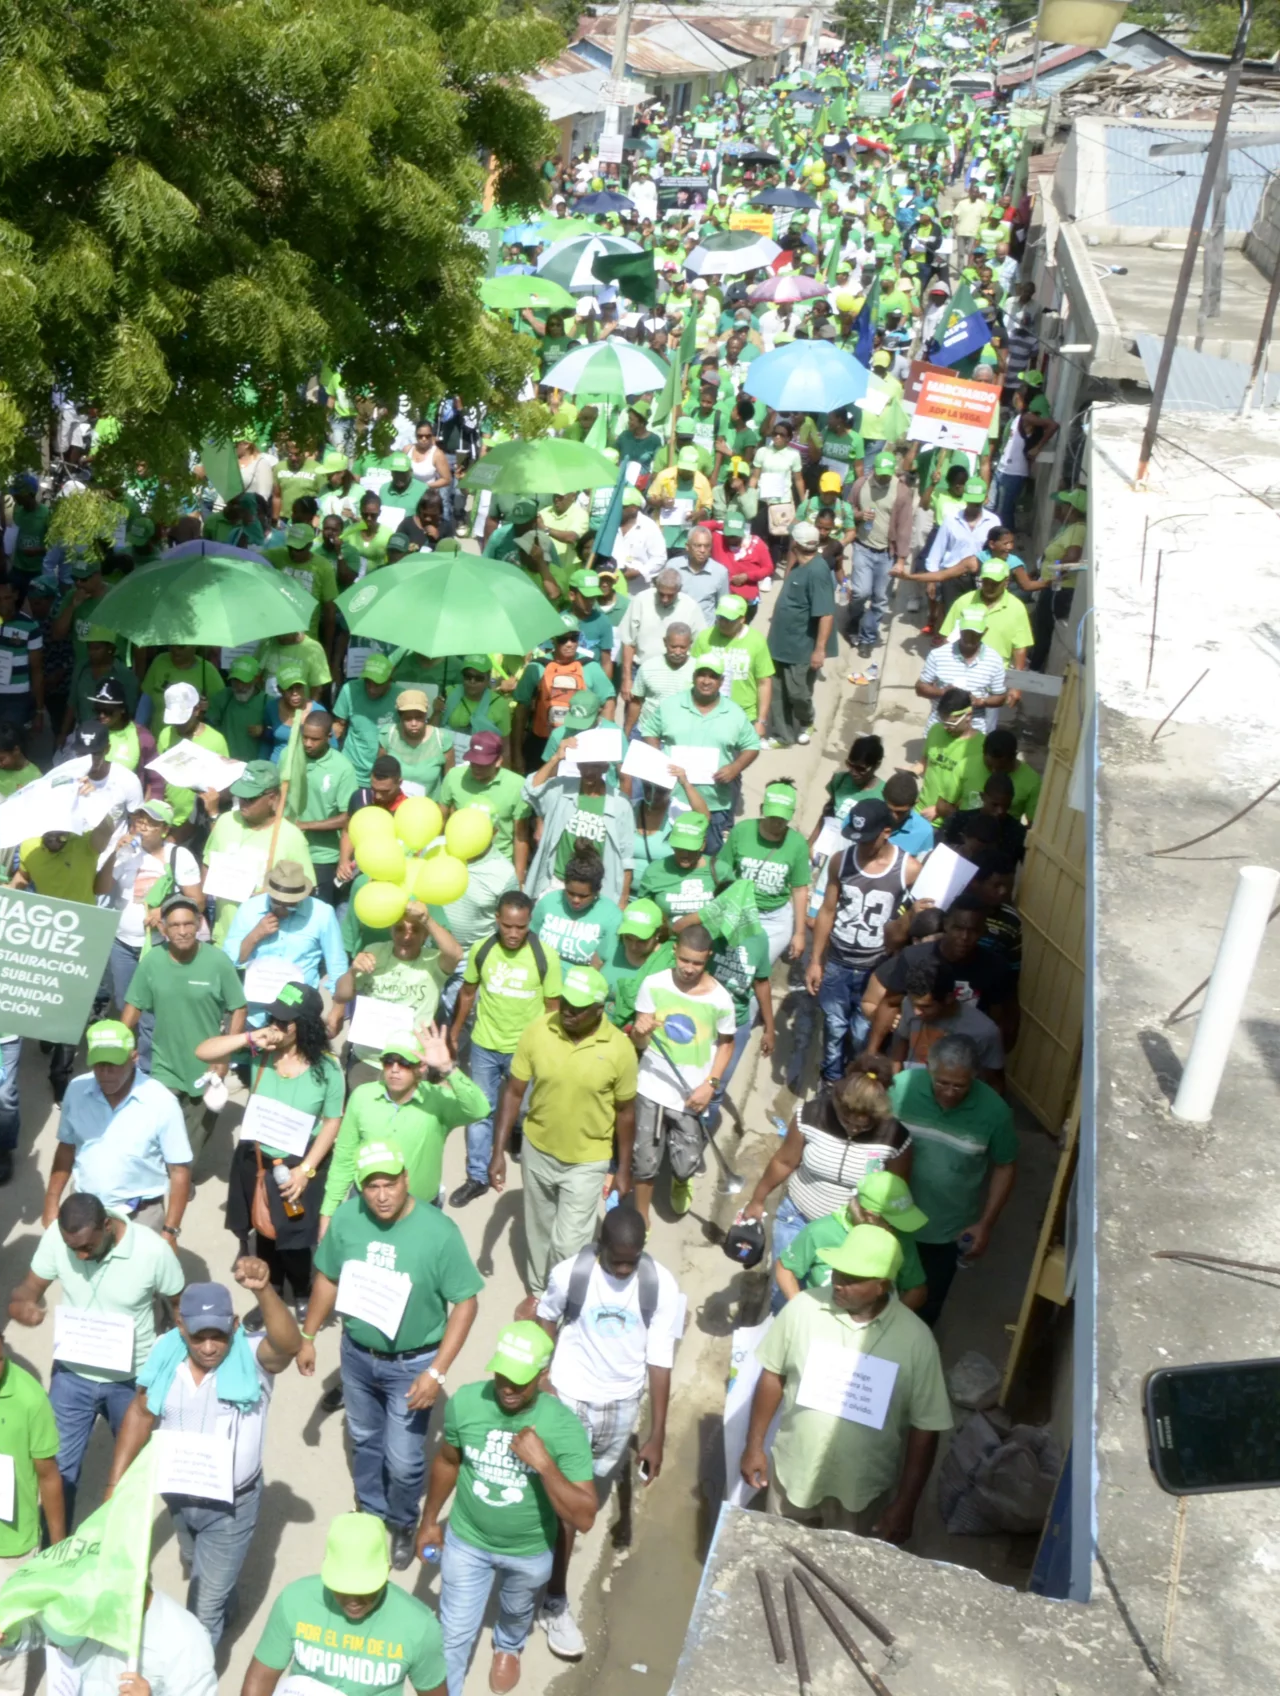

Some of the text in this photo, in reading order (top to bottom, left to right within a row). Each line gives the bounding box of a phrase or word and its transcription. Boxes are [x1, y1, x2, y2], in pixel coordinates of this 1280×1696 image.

[948, 409, 958, 417] LA
[960, 411, 981, 423] VEGA
[543, 913, 601, 942] SANTIAGO
[832, 885, 895, 947] 23
[562, 939, 577, 955] EL
[0, 966, 60, 989] SUBLEVA
[296, 1621, 404, 1659] POR EL FIN DE LA
[294, 1639, 402, 1686] IMPUNIDAD
